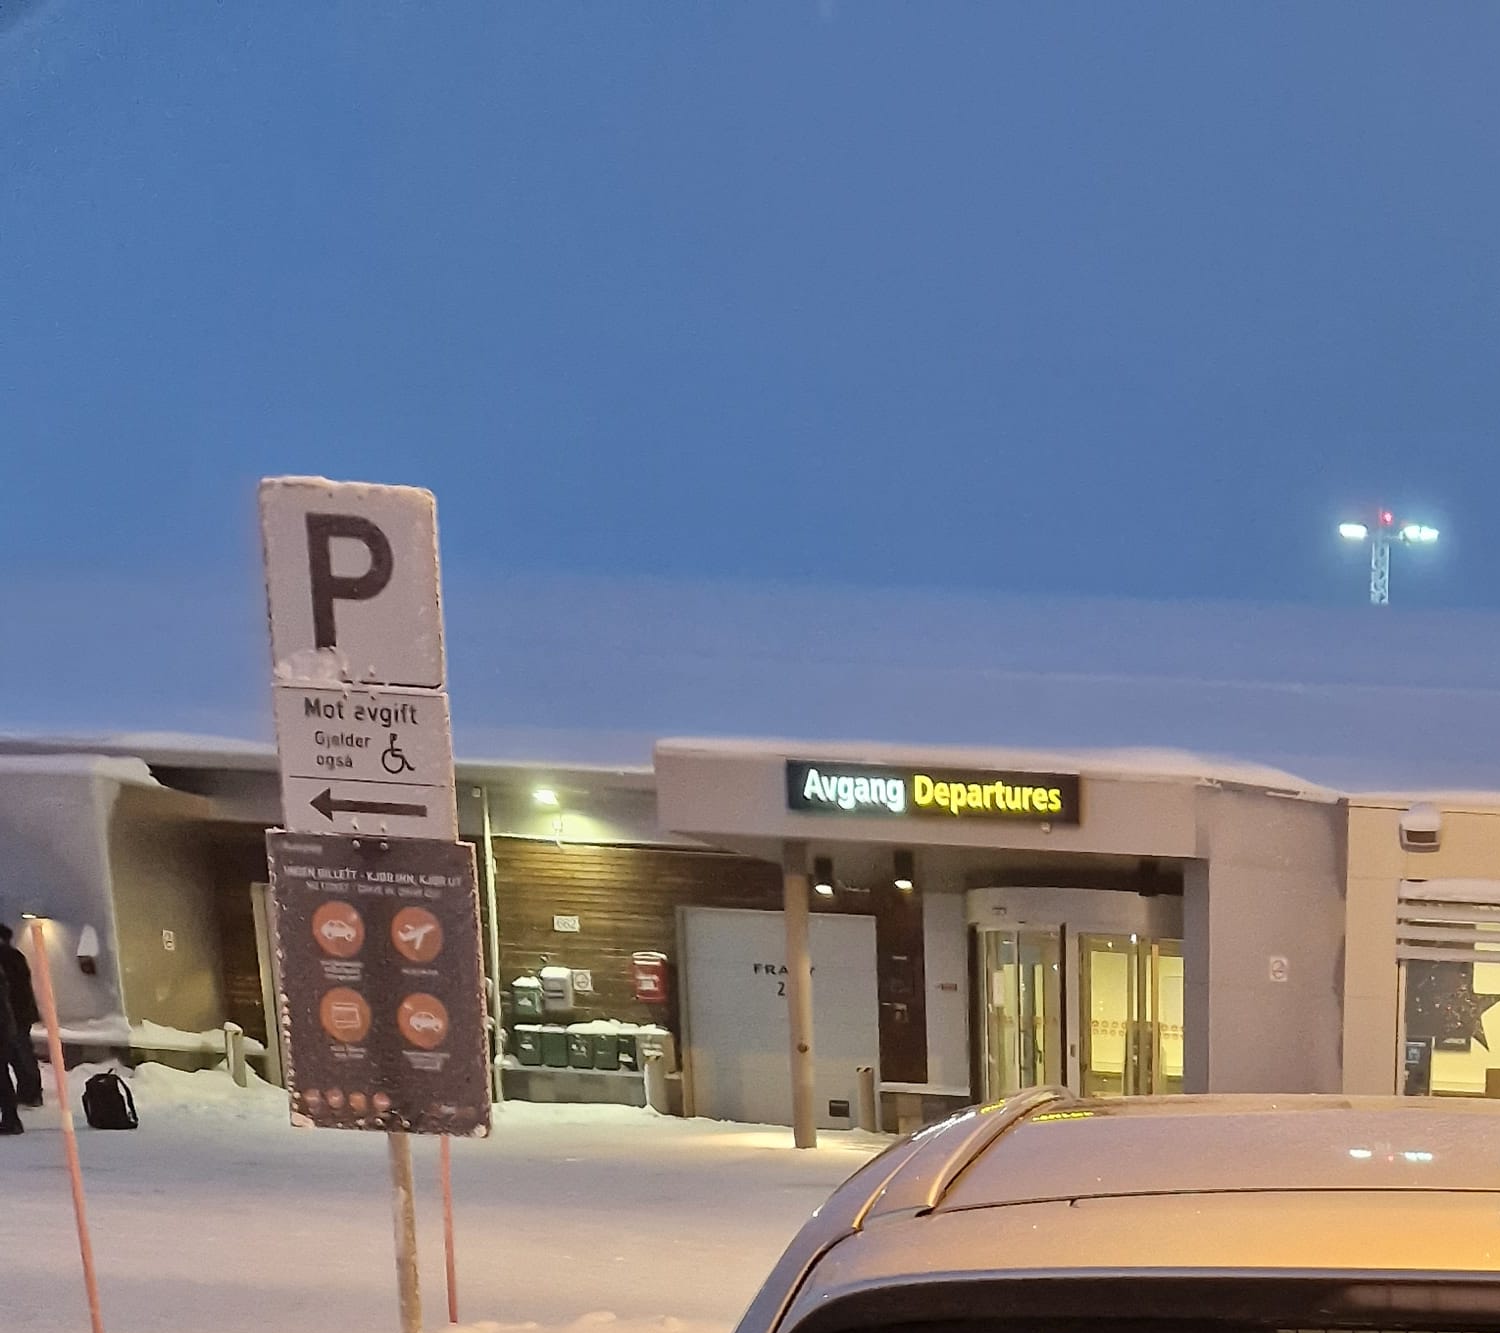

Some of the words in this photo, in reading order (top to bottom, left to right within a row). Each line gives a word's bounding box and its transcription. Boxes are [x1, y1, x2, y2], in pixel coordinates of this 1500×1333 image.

[305, 512, 394, 648] P
[304, 697, 344, 720] Mot
[355, 703, 418, 728] avgift
[803, 768, 906, 812] Avgang
[914, 774, 1062, 816] Departures
[777, 981, 786, 997] 2
